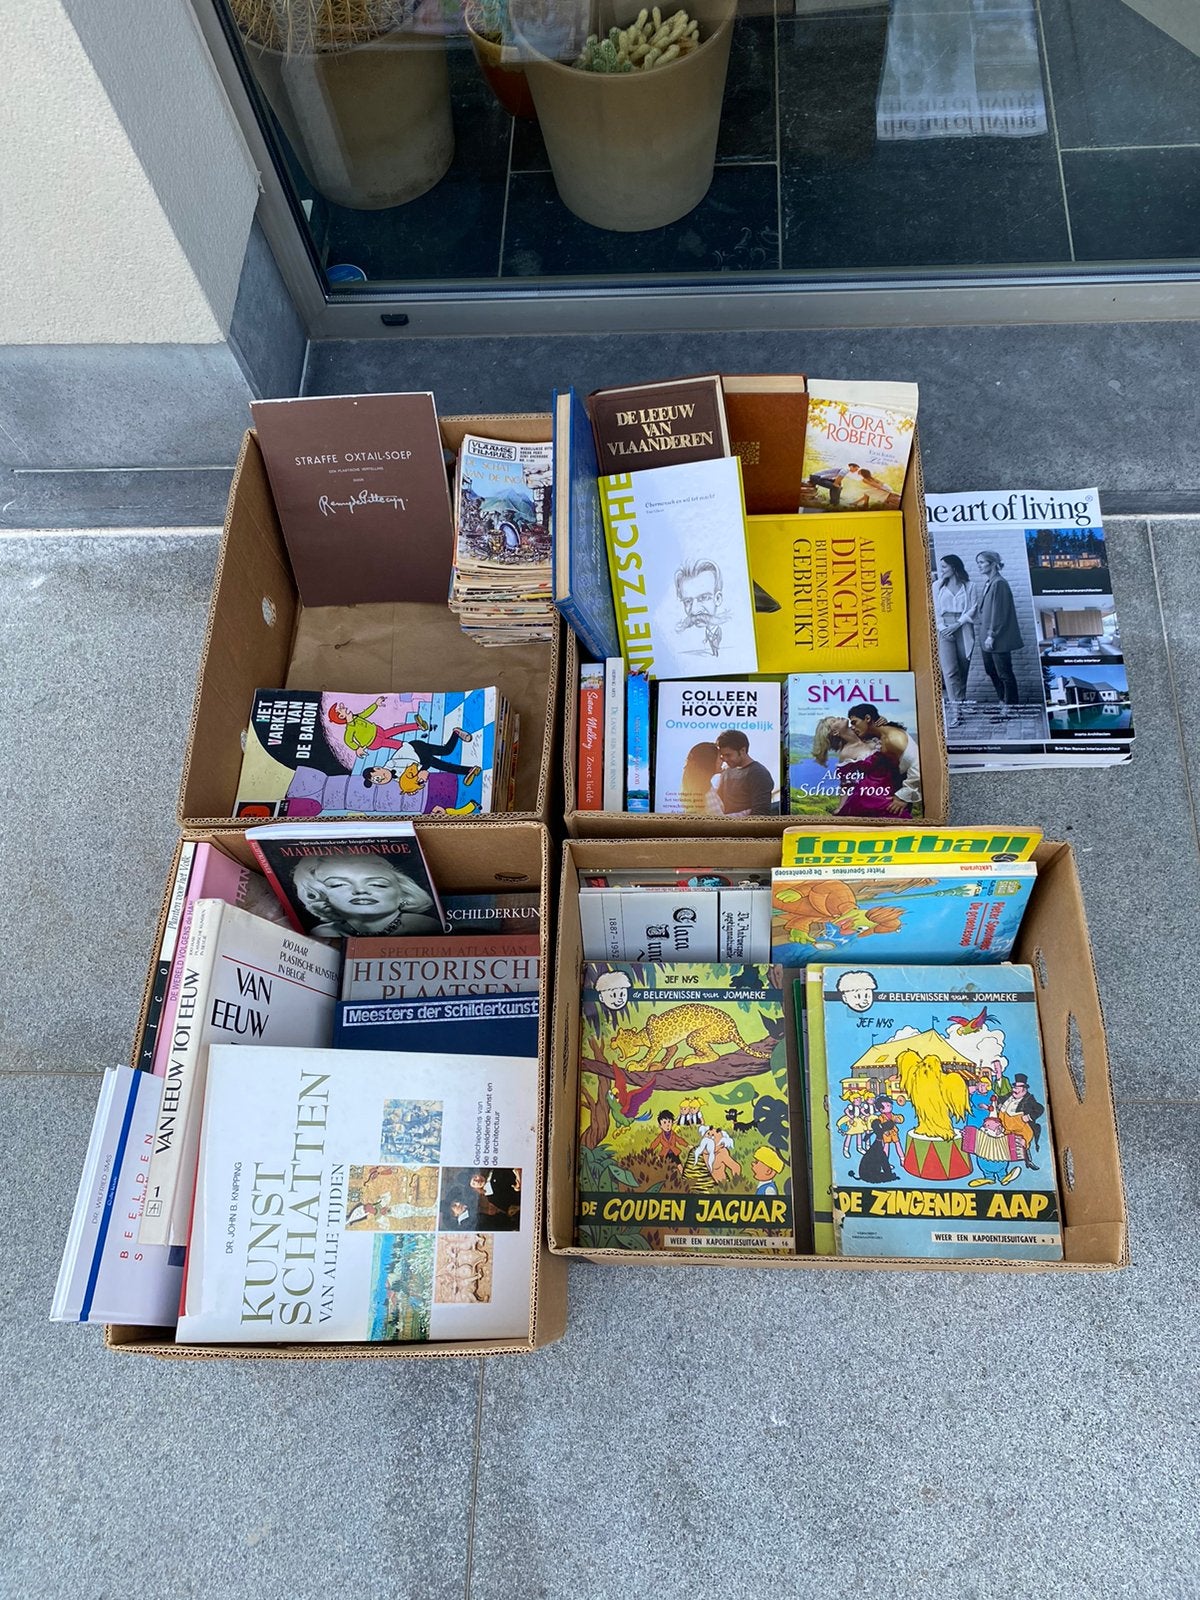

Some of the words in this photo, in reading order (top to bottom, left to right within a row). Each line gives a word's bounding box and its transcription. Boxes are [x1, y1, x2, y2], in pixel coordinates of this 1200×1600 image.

[615, 410, 638, 426] DE
[639, 404, 695, 423] LEEUW
[839, 413, 885, 434] NORA
[641, 421, 672, 437] VAN
[827, 423, 893, 450] ROBERTS
[471, 441, 513, 453] VLAAMSE
[607, 431, 713, 456] VLAANDEREN
[294, 454, 339, 466] STRAFFE
[344, 451, 412, 462] OXTAIL-SOEP
[482, 461, 511, 471] SCHAT
[464, 469, 484, 479] VAN
[488, 473, 499, 481] DE
[925, 504, 949, 523] he
[951, 500, 990, 522] art
[992, 494, 1018, 521] of
[1021, 494, 1092, 527] living
[607, 472, 656, 681] NIETZSCHE
[793, 538, 814, 651] GEBRUIKT
[815, 540, 829, 648] BUITENGEWOON
[831, 538, 859, 649] DINGEN
[860, 537, 878, 649] ALLEDAAGSE
[586, 691, 599, 715] Susan
[682, 690, 758, 702] COLLEEN
[808, 684, 899, 703] SMALL
[256, 700, 273, 722] HET
[286, 701, 304, 724] VAN
[298, 702, 319, 741] BARON
[682, 705, 758, 717] HOOVER
[267, 701, 288, 746] VARKEN
[582, 716, 599, 750] Mallory
[665, 719, 774, 732] Onvoorwaardelijk
[295, 744, 312, 759] DE
[586, 756, 595, 779] Zoete
[822, 768, 842, 780] Als
[845, 769, 864, 780] een
[586, 780, 595, 803] liefde
[797, 780, 854, 799] Schotse
[860, 785, 891, 797] roos
[280, 846, 344, 858] MARILYN
[347, 843, 411, 856] MONROE
[794, 834, 1030, 855] football
[183, 855, 192, 871] Volk
[774, 869, 811, 877] groentesoep
[832, 868, 869, 876] Speurneus
[870, 867, 886, 875] Pieter
[179, 870, 188, 885] het
[235, 867, 250, 903] HAN
[175, 883, 186, 902] voor
[168, 901, 181, 930] Planten
[446, 907, 540, 921] SCHILDERKUN
[673, 907, 698, 951] Clara
[178, 924, 192, 960] VOLGENS
[282, 938, 294, 952] 100
[294, 943, 309, 957] JAAR
[381, 946, 451, 958] SPECTRUM
[456, 946, 499, 957] ATLAS
[502, 945, 529, 956] VAN
[172, 960, 184, 990] WERELD
[278, 963, 286, 976] IN
[280, 951, 314, 973] PLASTISCHE
[315, 966, 339, 982] KUNSTEN
[236, 967, 273, 1005] VAN
[665, 975, 680, 984] JEF
[682, 975, 700, 984] NYS
[170, 990, 177, 1001] DE
[178, 968, 201, 1021] EEUW
[382, 983, 521, 1001] PLAATSEN
[632, 991, 642, 999] de
[643, 991, 700, 1000] BELEVENISSEN
[723, 991, 767, 1000] JOMMEKE
[877, 993, 888, 1001] de
[889, 993, 950, 1002] BELEVENISSEN
[972, 993, 1018, 1002] JOMMEKE
[210, 998, 269, 1039] EEUW
[349, 1006, 414, 1023] Meesters
[417, 1004, 440, 1020] der
[444, 999, 539, 1018] Schilderkunst
[856, 1018, 874, 1029] JEF
[876, 1018, 895, 1029] NYS
[172, 1022, 192, 1055] TOT
[162, 1060, 186, 1113] EEUW
[488, 1082, 493, 1092] en
[485, 1093, 493, 1114] kunst
[155, 1116, 176, 1155] VAN
[473, 1116, 482, 1166] Geschiedenis
[483, 1115, 492, 1154] beeldende
[492, 1111, 501, 1154] architectuur
[482, 1156, 489, 1166] de
[491, 1156, 499, 1166] de
[231, 1161, 243, 1202] KNIPPING
[279, 1068, 332, 1326] SCHATTEN
[326, 1162, 345, 1228] TIJDEN
[838, 1191, 863, 1214] DE
[869, 1189, 978, 1218] ZINGENDE
[986, 1193, 1050, 1219] AAP
[230, 1202, 238, 1211] B.
[581, 1201, 598, 1217] DE
[603, 1198, 686, 1222] GOUDEN
[695, 1200, 787, 1224] JAGUAR
[227, 1211, 238, 1238] JOHN
[226, 1239, 234, 1255] DR.
[240, 1161, 286, 1326] KUNST
[670, 1237, 687, 1246] WEER
[691, 1237, 703, 1246] EEN
[706, 1238, 767, 1247] KAPOENTJESUITGAVE
[935, 1234, 953, 1242] WEER
[972, 1235, 1038, 1244] KAPOENTJESUITGAVE
[323, 1232, 341, 1280] ALLE
[319, 1285, 336, 1325] VAN
